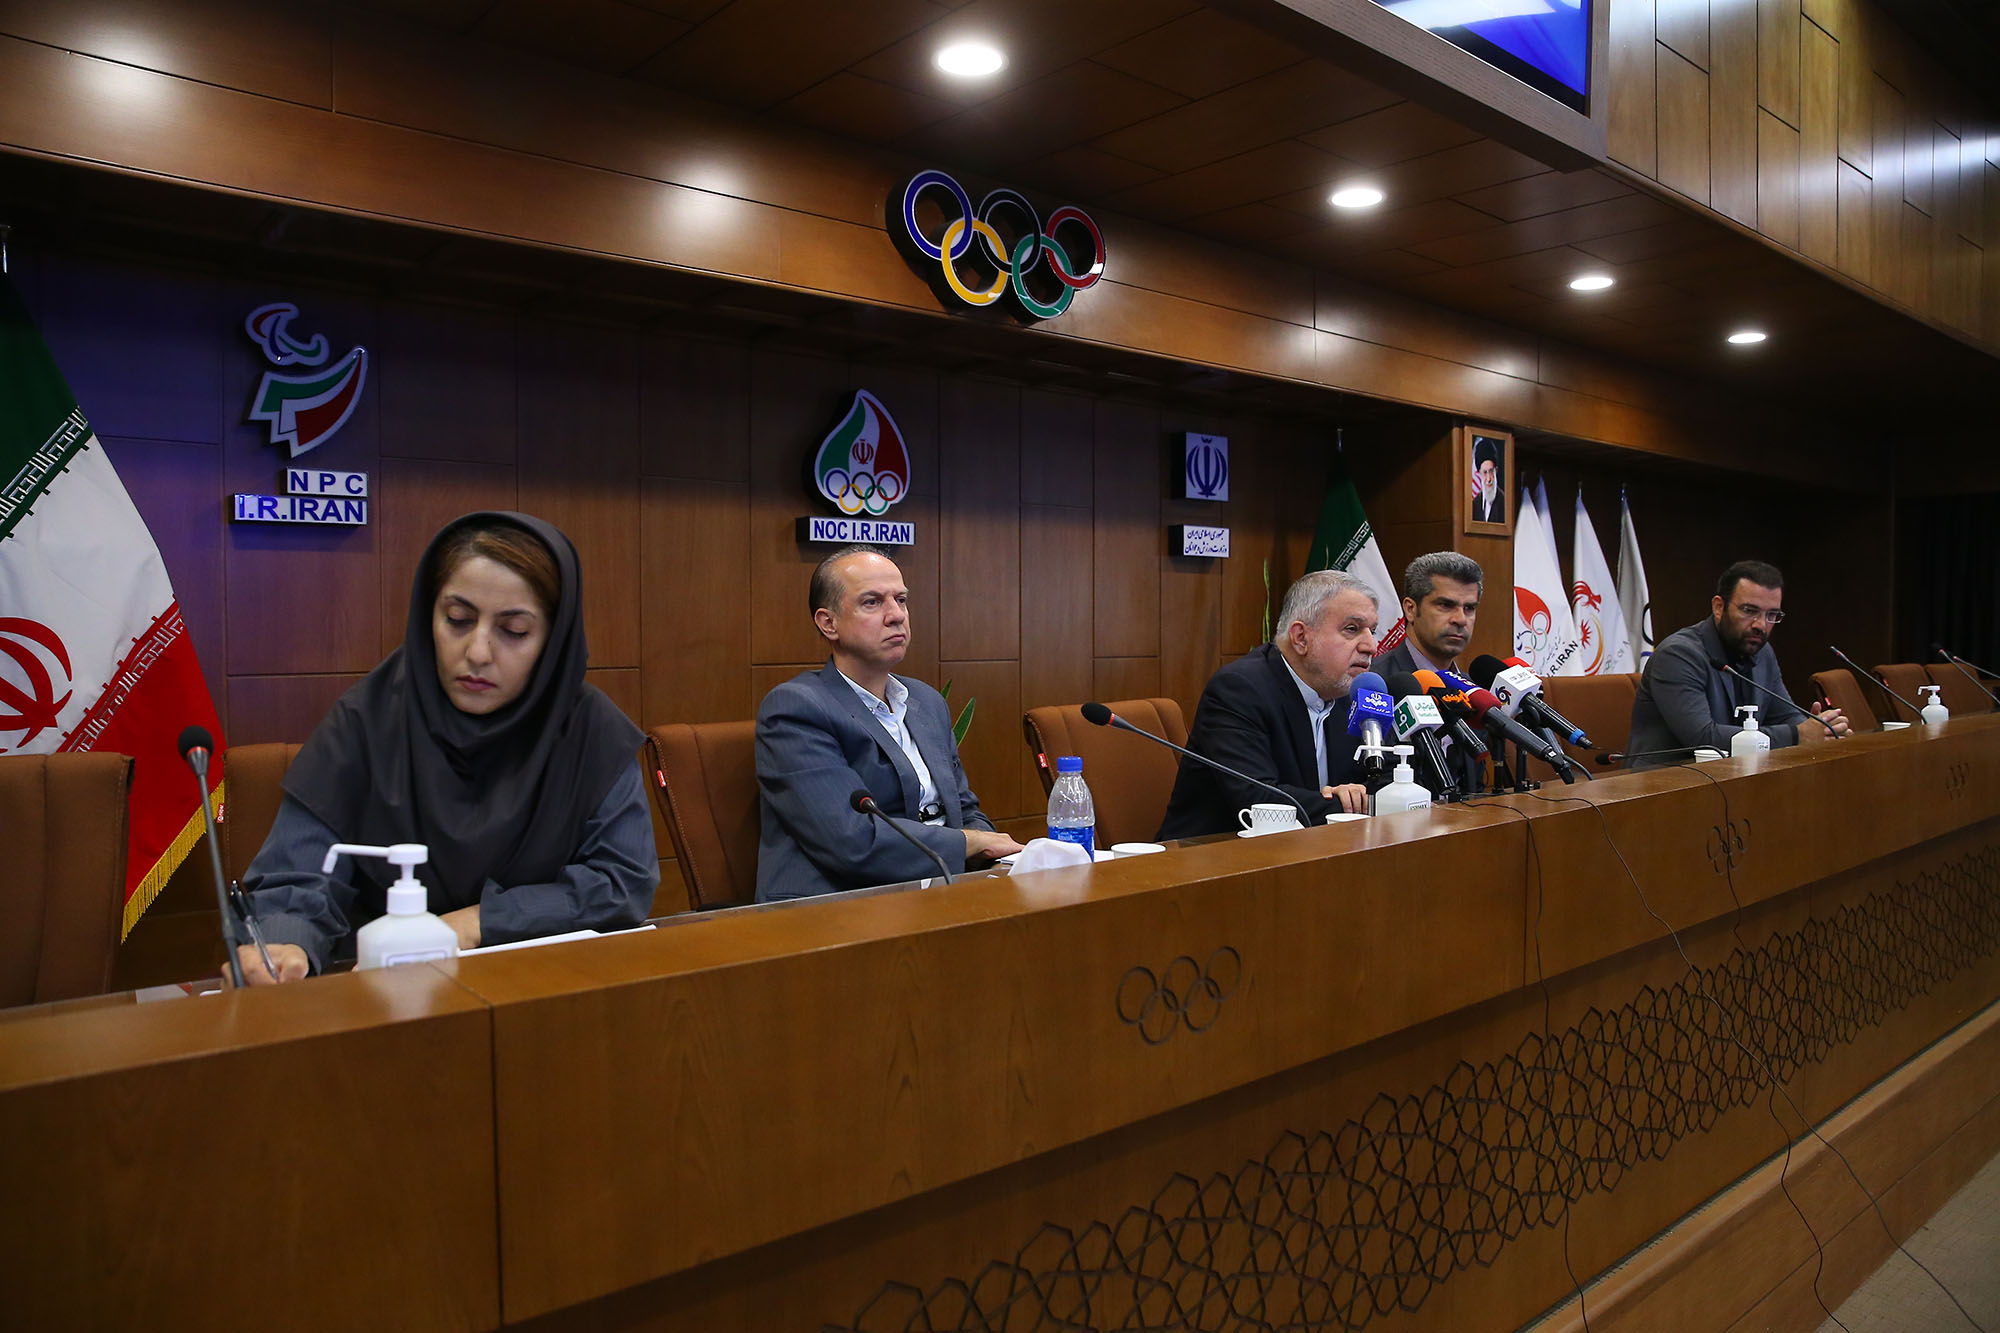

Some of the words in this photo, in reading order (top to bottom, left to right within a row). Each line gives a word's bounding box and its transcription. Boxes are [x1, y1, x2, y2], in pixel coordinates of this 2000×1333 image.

[239, 496, 363, 522] I.R.IRAN
[814, 520, 847, 540] NOC
[852, 522, 910, 543] I.R.IRAN
[1187, 530, 1198, 540] ایران
[1210, 530, 1224, 540] جمهوری
